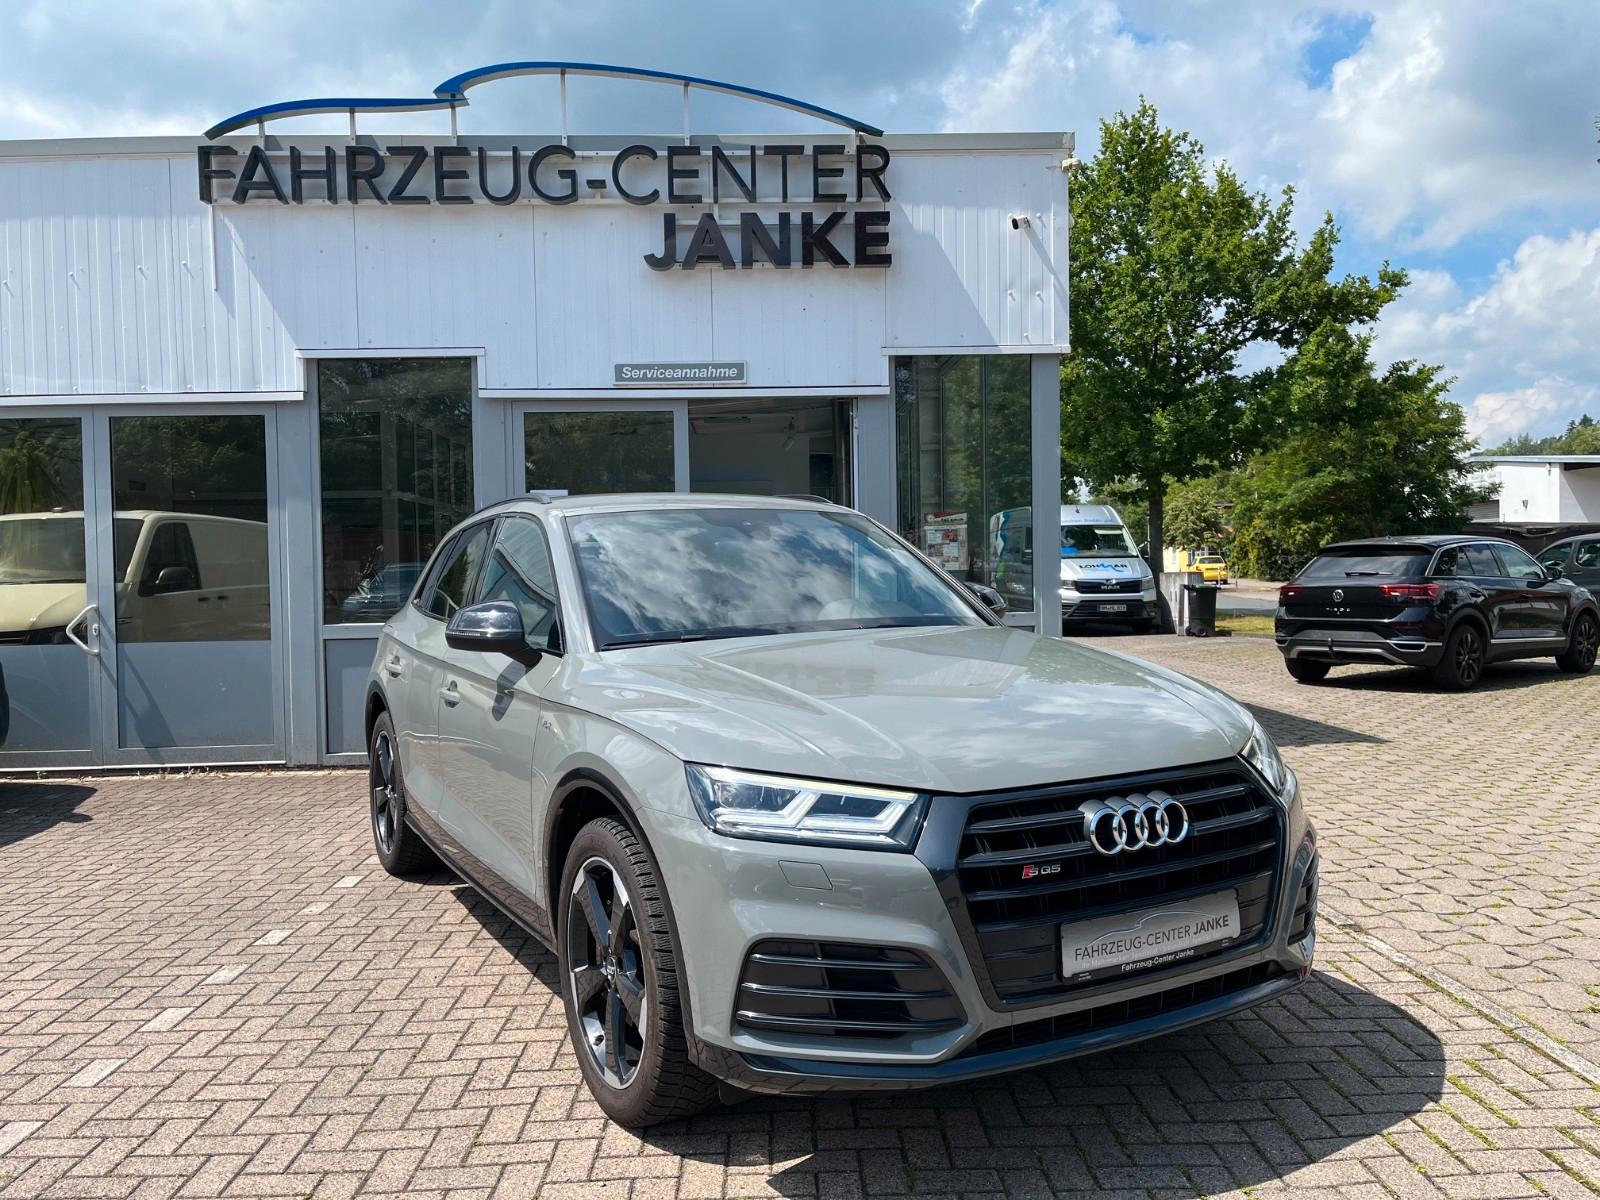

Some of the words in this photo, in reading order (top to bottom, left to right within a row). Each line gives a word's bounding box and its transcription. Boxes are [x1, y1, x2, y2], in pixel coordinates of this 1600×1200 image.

[198, 144, 891, 205] FAHRZEUG-CENTER
[643, 211, 892, 271] JANKE
[622, 366, 738, 378] Serviceannahme
[1075, 925, 1191, 961] FAHRZEUG-CENTER
[1193, 915, 1229, 936] JANKE
[1121, 954, 1175, 972] Fahrzeug-Center
[1175, 949, 1194, 960] Janke
